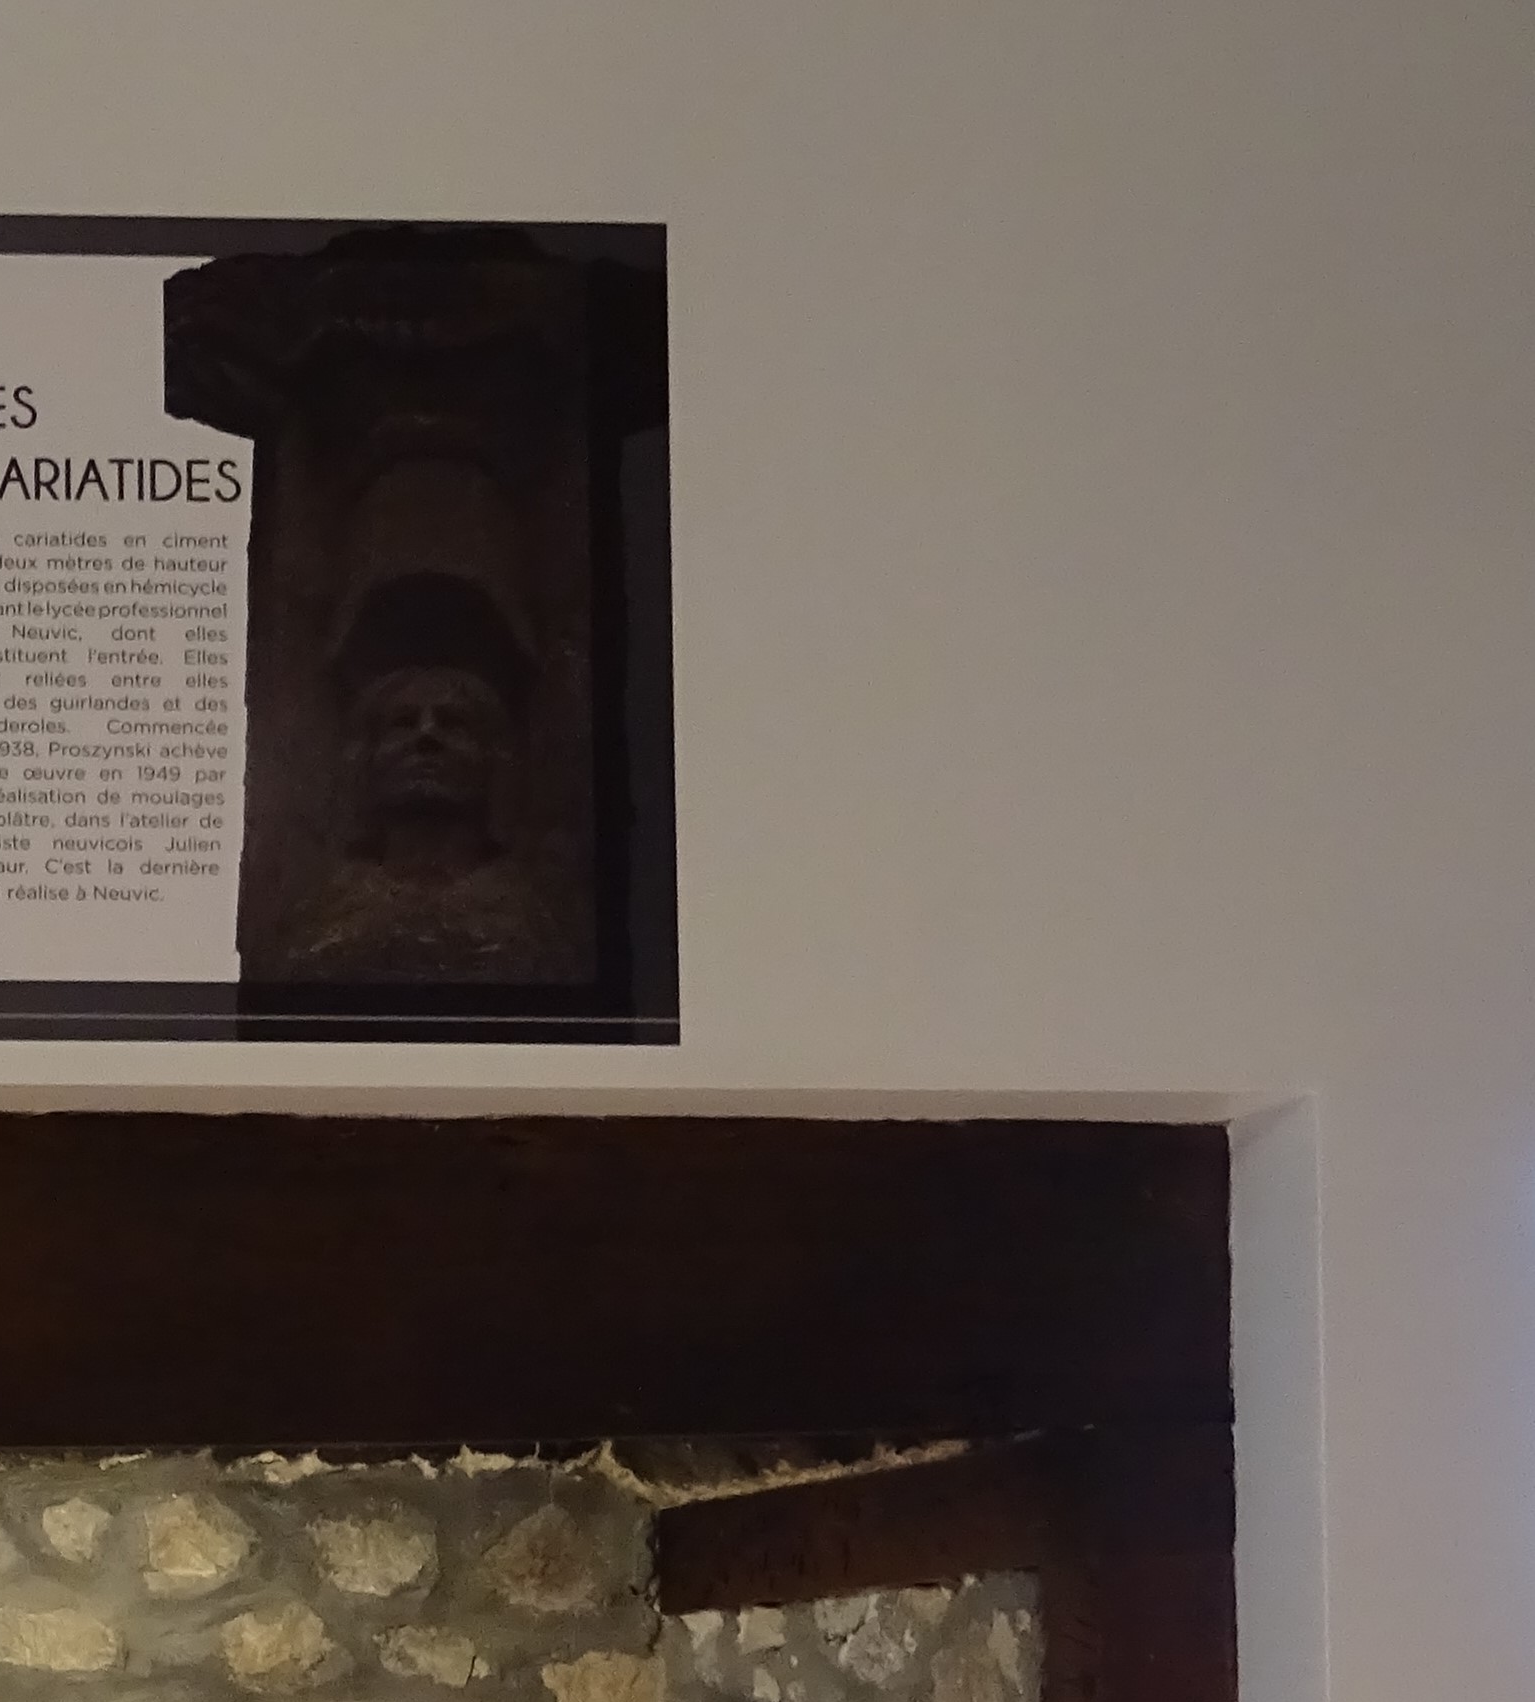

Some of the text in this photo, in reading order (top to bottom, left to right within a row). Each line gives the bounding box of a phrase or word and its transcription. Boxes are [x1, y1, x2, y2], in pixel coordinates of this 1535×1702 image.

[13, 529, 108, 547] cariatides
[123, 533, 147, 547] en
[161, 530, 228, 548] ciment
[3, 575, 100, 597] disposées
[103, 580, 127, 594] en
[130, 576, 227, 598] hémicycle
[11, 621, 83, 642] Neuvic,
[111, 623, 156, 641] dont
[184, 624, 229, 642] elles
[88, 646, 163, 664] l'entrée.
[183, 647, 229, 665] Elles
[3, 692, 38, 710] des
[49, 692, 150, 714] guirlandes
[162, 693, 181, 711] et
[194, 694, 228, 712] des
[48, 740, 151, 761] Proszynski
[159, 740, 228, 758] achève
[52, 832, 143, 851] neuvicois
[164, 834, 222, 852] Julien
[44, 856, 92, 874] C'est
[107, 857, 124, 875] la
[139, 857, 221, 875] dernière
[7, 882, 70, 900] réalise
[75, 883, 87, 900] à
[92, 883, 164, 901] Neuvic.
